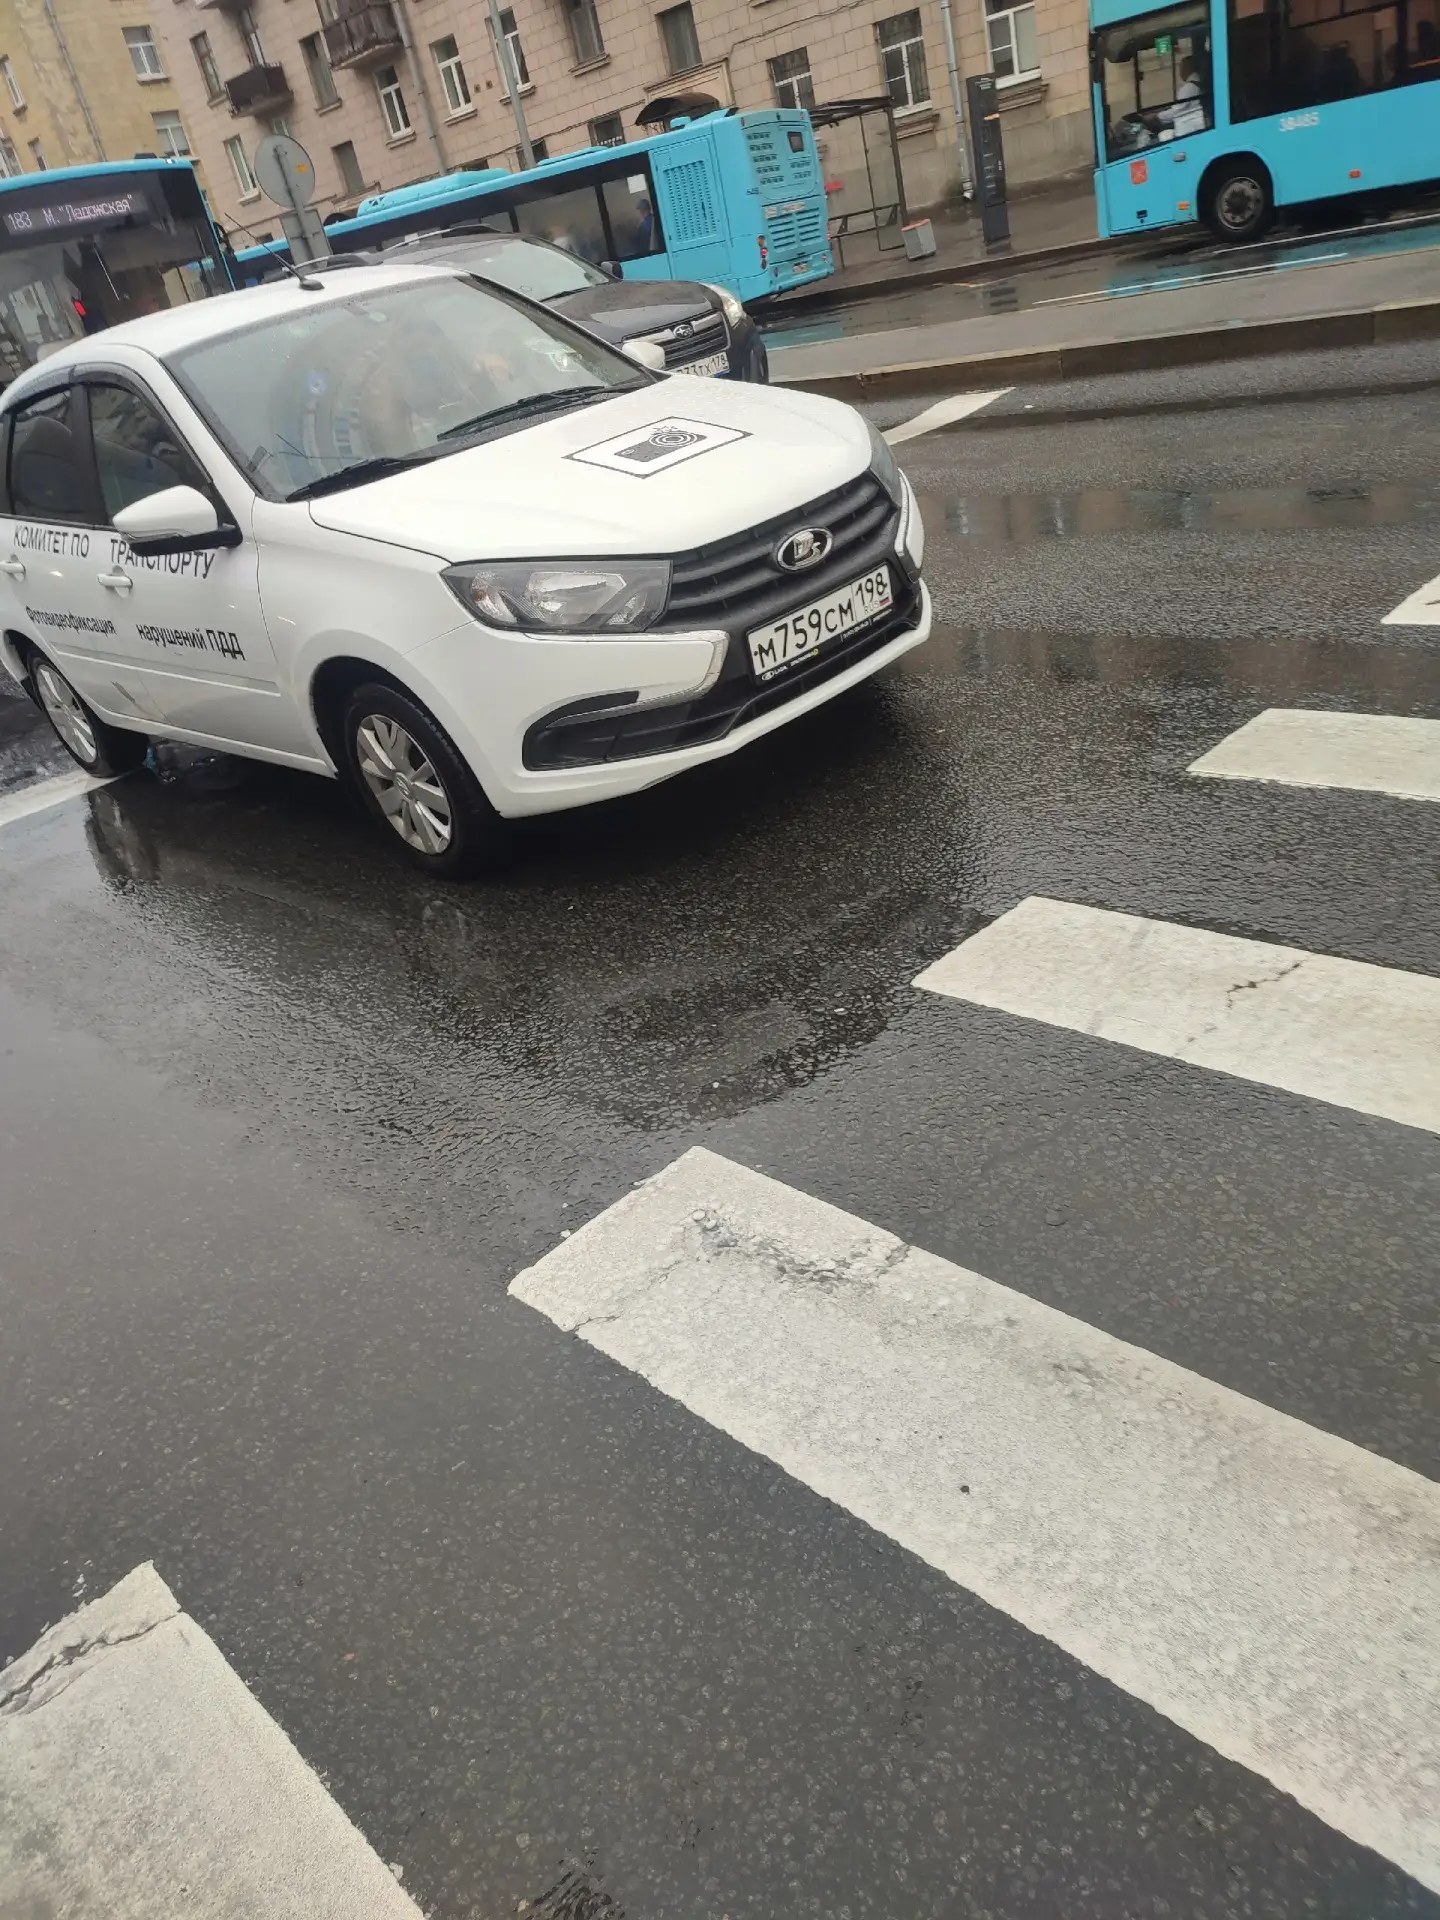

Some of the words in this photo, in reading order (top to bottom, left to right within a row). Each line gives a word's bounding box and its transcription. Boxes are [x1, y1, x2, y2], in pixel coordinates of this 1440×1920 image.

[8, 211, 32, 230] 183
[14, 524, 69, 554] КОМИТЕТ
[71, 533, 90, 558] ПО
[25, 605, 118, 639] Фотовидеофиксация
[136, 623, 207, 650] нарушений
[206, 629, 246, 661] ПДД
[757, 598, 854, 669] М759СМ
[855, 572, 888, 606] 198
